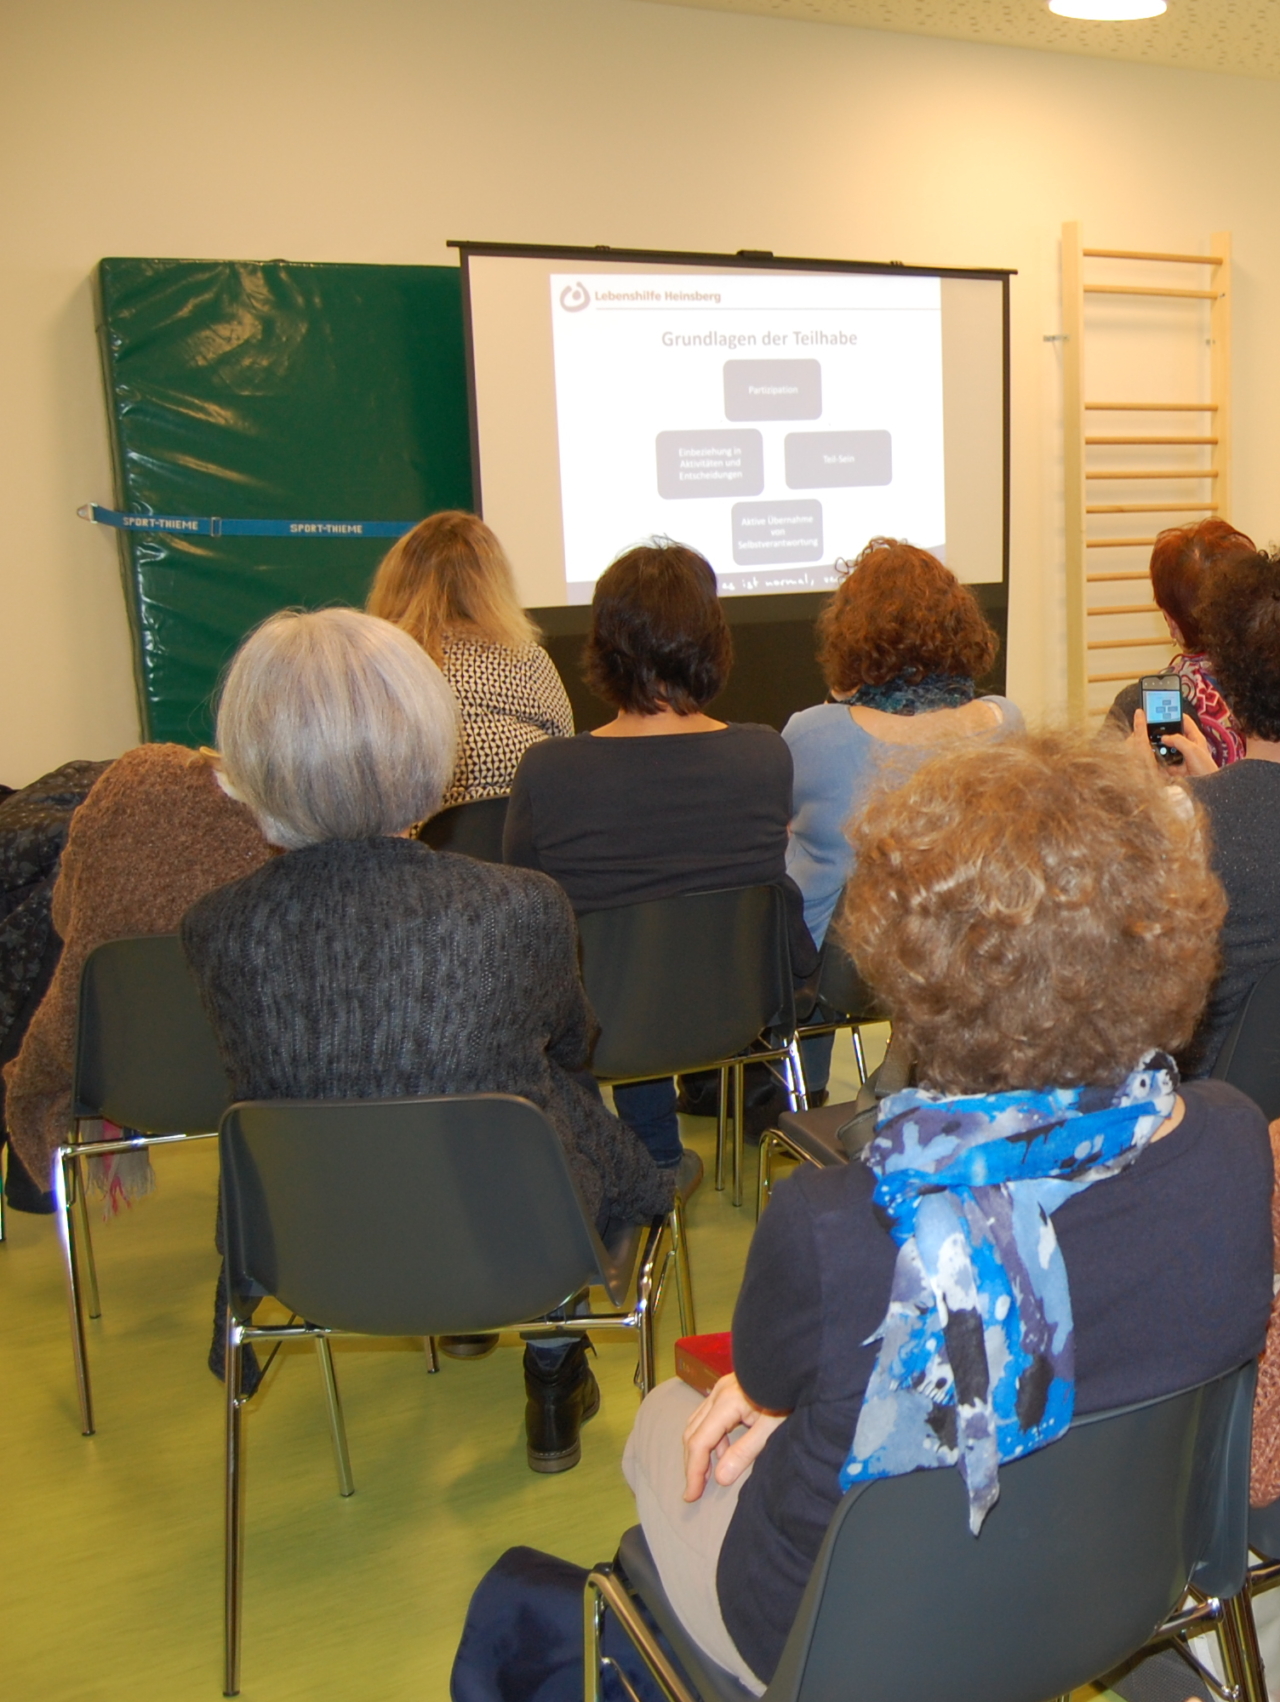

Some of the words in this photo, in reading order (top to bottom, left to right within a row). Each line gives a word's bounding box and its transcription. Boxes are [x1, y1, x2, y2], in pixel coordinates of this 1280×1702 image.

[594, 290, 662, 301] Lebenshilfe
[664, 290, 721, 304] Heinsberg
[661, 330, 757, 350] Grundlagen
[761, 330, 788, 346] der
[792, 330, 858, 346] Teilhabe
[748, 384, 799, 396] Partizipation
[678, 446, 733, 458] Einbeziehung
[733, 446, 742, 455] in
[680, 458, 723, 468] Aktivitäten
[725, 458, 742, 467] und
[823, 454, 856, 464] Teil-Sein
[678, 470, 743, 481] Entscheidungen
[122, 516, 199, 531] SPORT-THIEME
[741, 516, 766, 526] Aktive
[767, 514, 814, 526] Übernahme
[289, 522, 363, 534] SPORT-THIEME
[770, 528, 786, 537] von
[737, 537, 819, 550] Selbstverantwortung
[742, 576, 759, 590] ist
[765, 573, 815, 587] normal,
